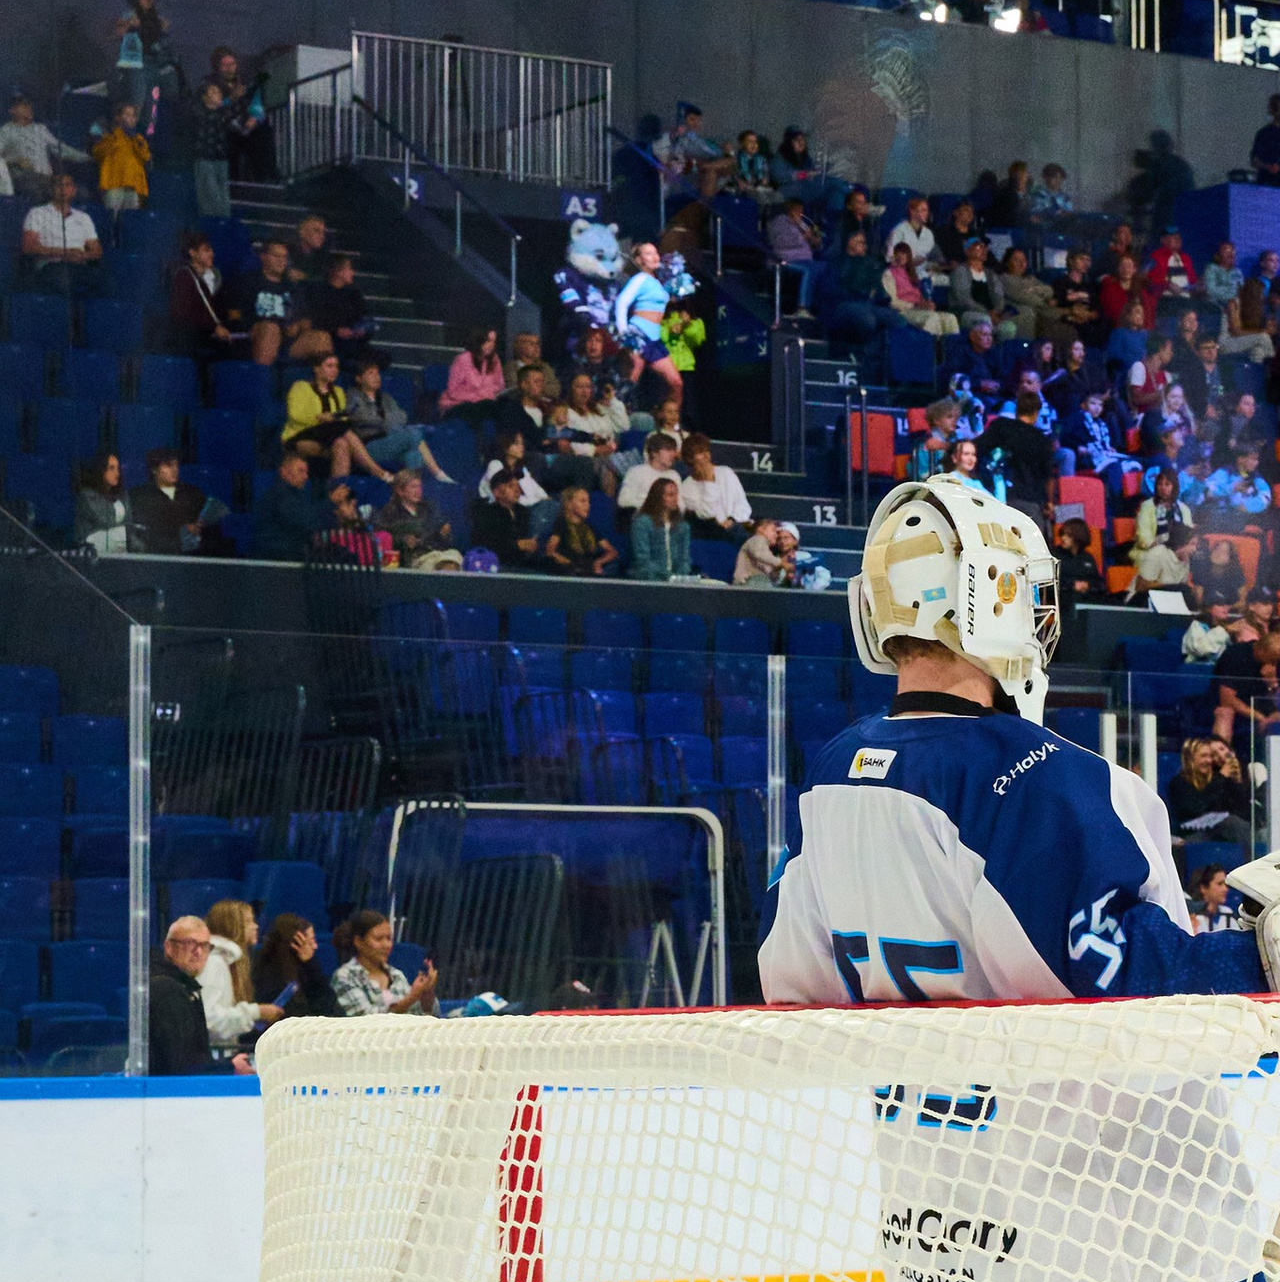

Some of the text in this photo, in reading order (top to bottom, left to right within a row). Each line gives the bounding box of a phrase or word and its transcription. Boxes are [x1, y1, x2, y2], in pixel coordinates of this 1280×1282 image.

[564, 195, 597, 218] A3
[836, 369, 859, 387] 16
[750, 450, 774, 473] 14
[812, 504, 839, 527] 13
[1009, 740, 1061, 779] Halyk
